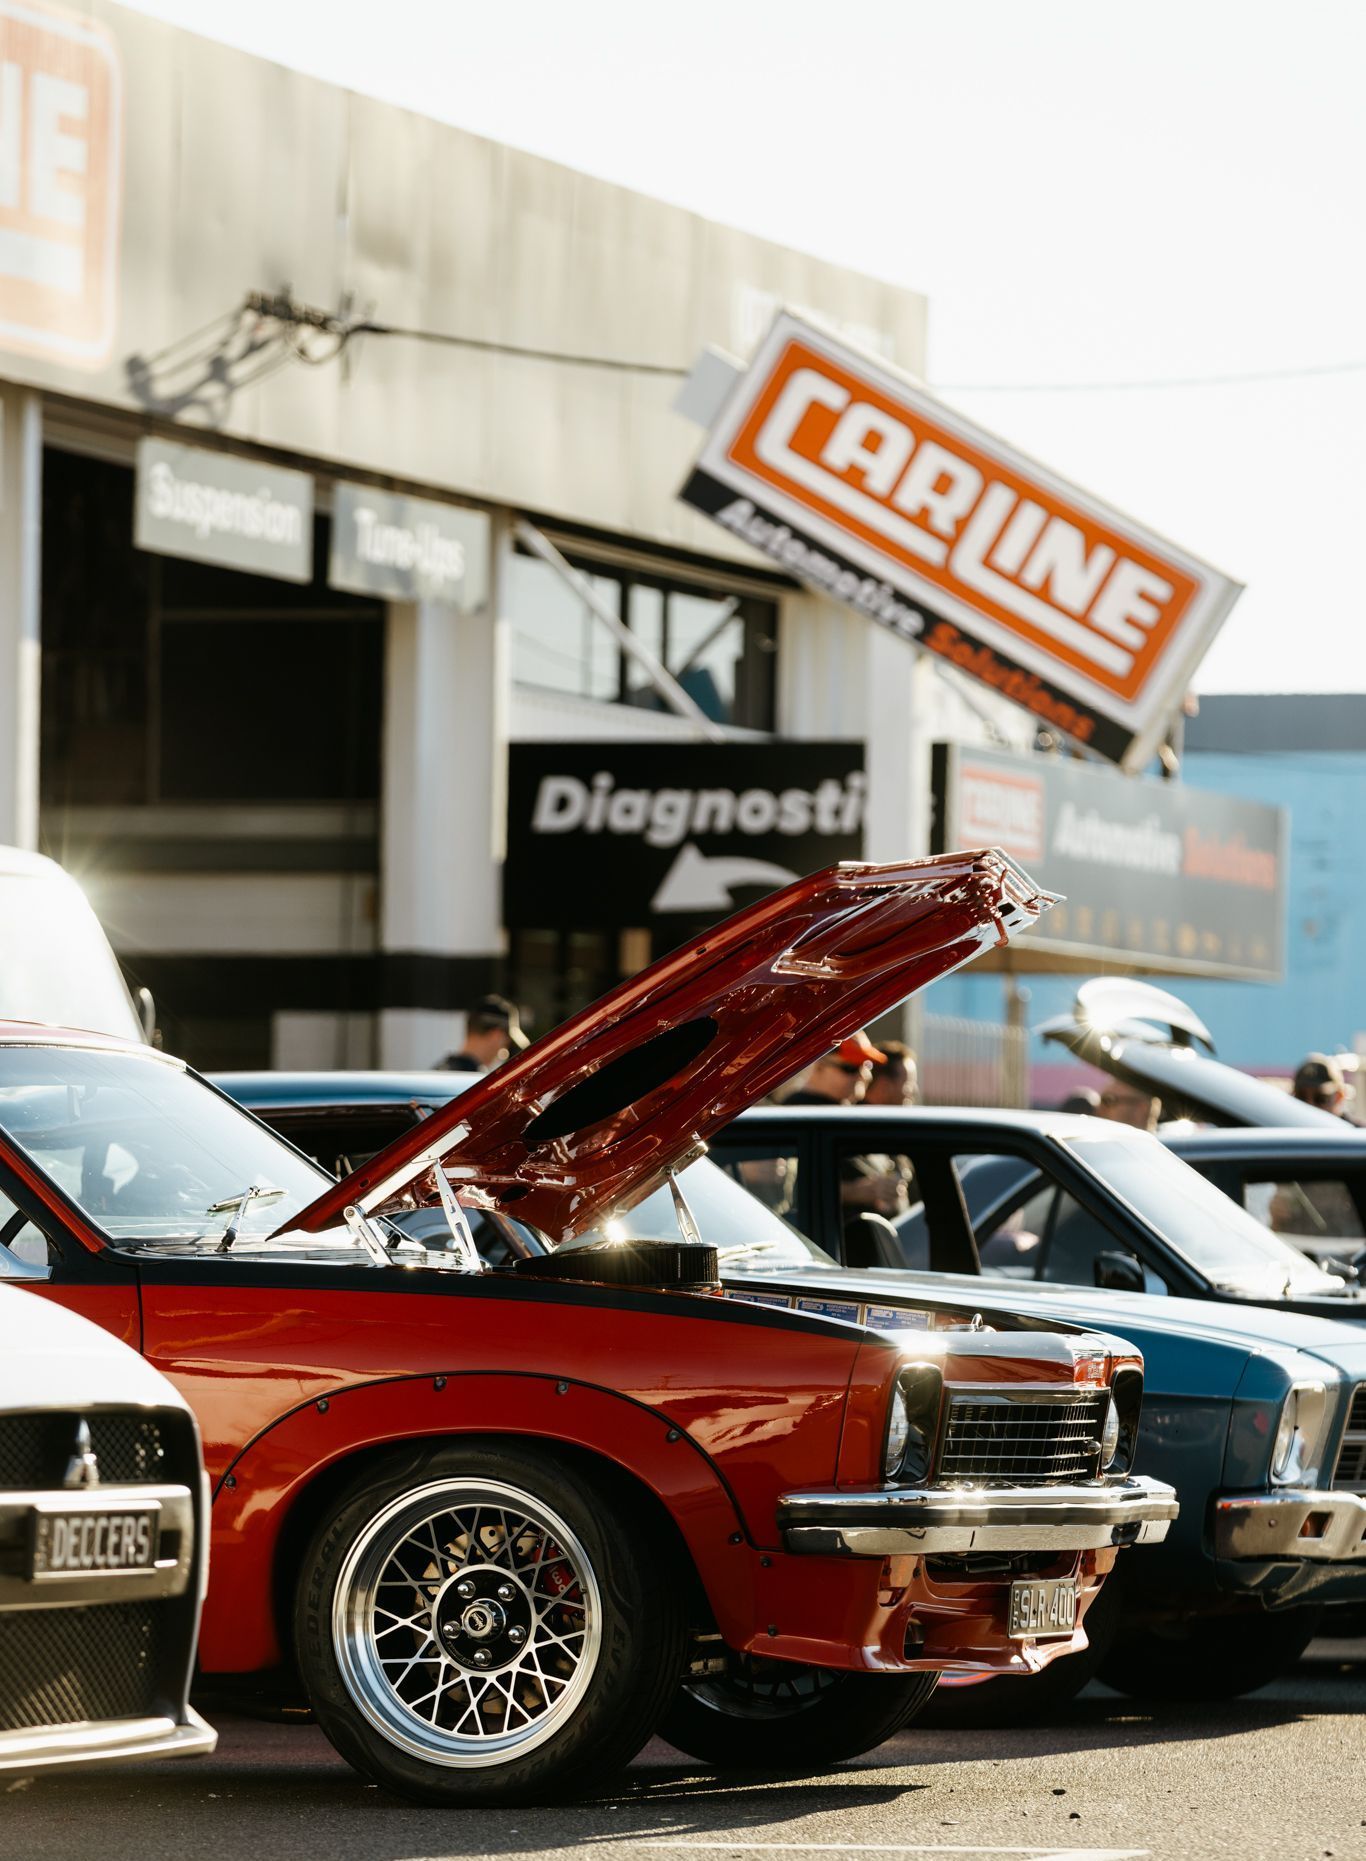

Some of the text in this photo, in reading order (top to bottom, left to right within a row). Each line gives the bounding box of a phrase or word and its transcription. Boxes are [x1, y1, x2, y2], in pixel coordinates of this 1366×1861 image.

[148, 462, 302, 546] Suspension
[754, 368, 1174, 680] CARLINE
[353, 506, 466, 582] Tune-Ups
[714, 502, 1096, 742] Automotive Solutions
[531, 770, 868, 848] Diagnosti
[50, 1515, 150, 1568] DECCERS
[1019, 1586, 1075, 1628] SLR 400
